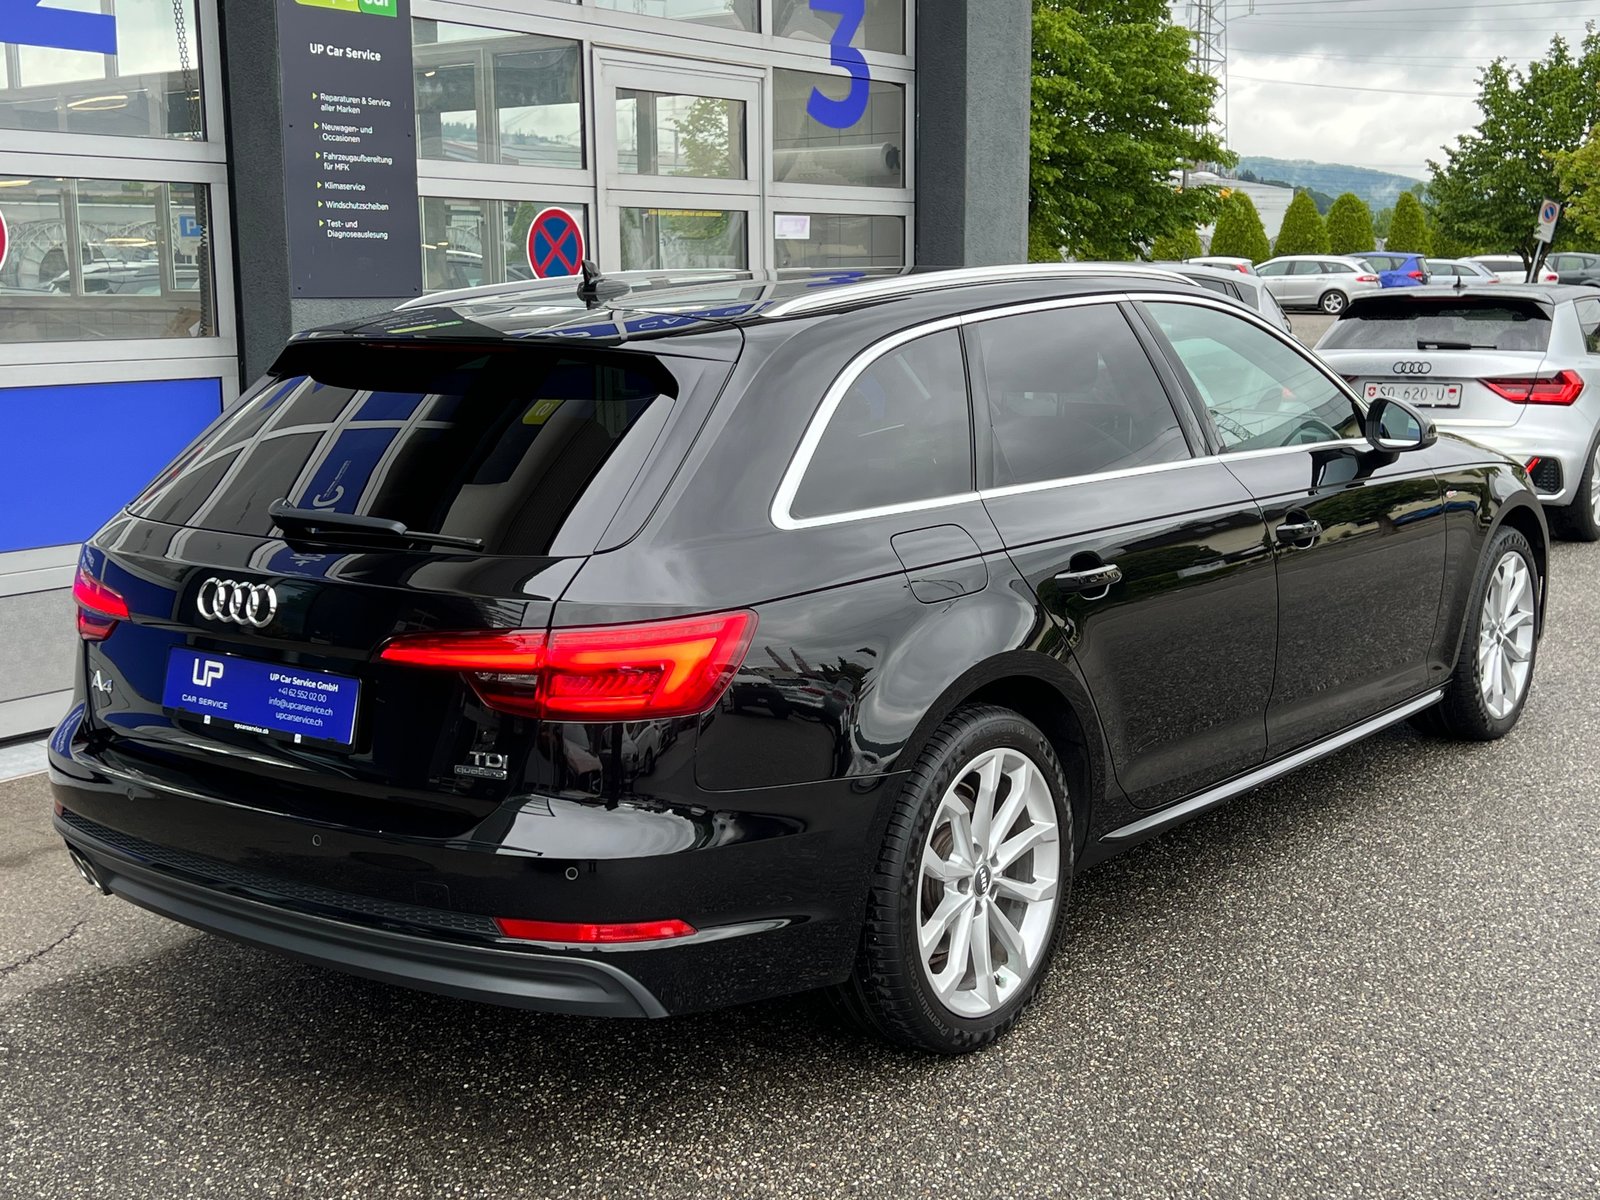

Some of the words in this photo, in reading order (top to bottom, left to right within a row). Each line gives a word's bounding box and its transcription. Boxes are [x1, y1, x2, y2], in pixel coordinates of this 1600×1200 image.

[309, 42, 325, 55] UP
[326, 45, 344, 57] Car
[345, 47, 382, 61] Service
[807, 0, 871, 129] 3
[320, 92, 361, 104] Reparaturen
[361, 96, 367, 105] &
[367, 97, 391, 107] Service
[320, 104, 336, 112] aller
[336, 104, 361, 114] Marken
[321, 122, 359, 133] Neuwagen-
[359, 126, 373, 134] und
[322, 132, 361, 143] Occasionen
[323, 152, 393, 165] Fahrzeugaufbereitung
[323, 162, 334, 171] für
[334, 163, 350, 172] MFK
[324, 181, 366, 191] Klimaservice
[325, 200, 389, 211] Windschutzscheiben
[326, 219, 344, 228] Test-
[344, 220, 358, 229] und
[327, 229, 388, 240] Diagnoseauslesung
[1403, 387, 1428, 400] 620
[192, 658, 224, 688] UP
[91, 670, 113, 694] A4
[269, 672, 280, 681] UP
[280, 674, 291, 684] Car
[292, 677, 316, 688] Service
[317, 681, 339, 692] GmbH
[181, 694, 197, 703] CAR
[198, 697, 228, 709] SERVICE
[278, 687, 288, 695] +41
[288, 688, 297, 697] 62
[308, 692, 317, 701] 02
[317, 694, 327, 702] 00
[268, 696, 333, 716] info@upcarservice.ch
[275, 712, 323, 727] upcarservice.ch
[234, 723, 269, 735] upcarservice.ch
[469, 751, 508, 769] TDI
